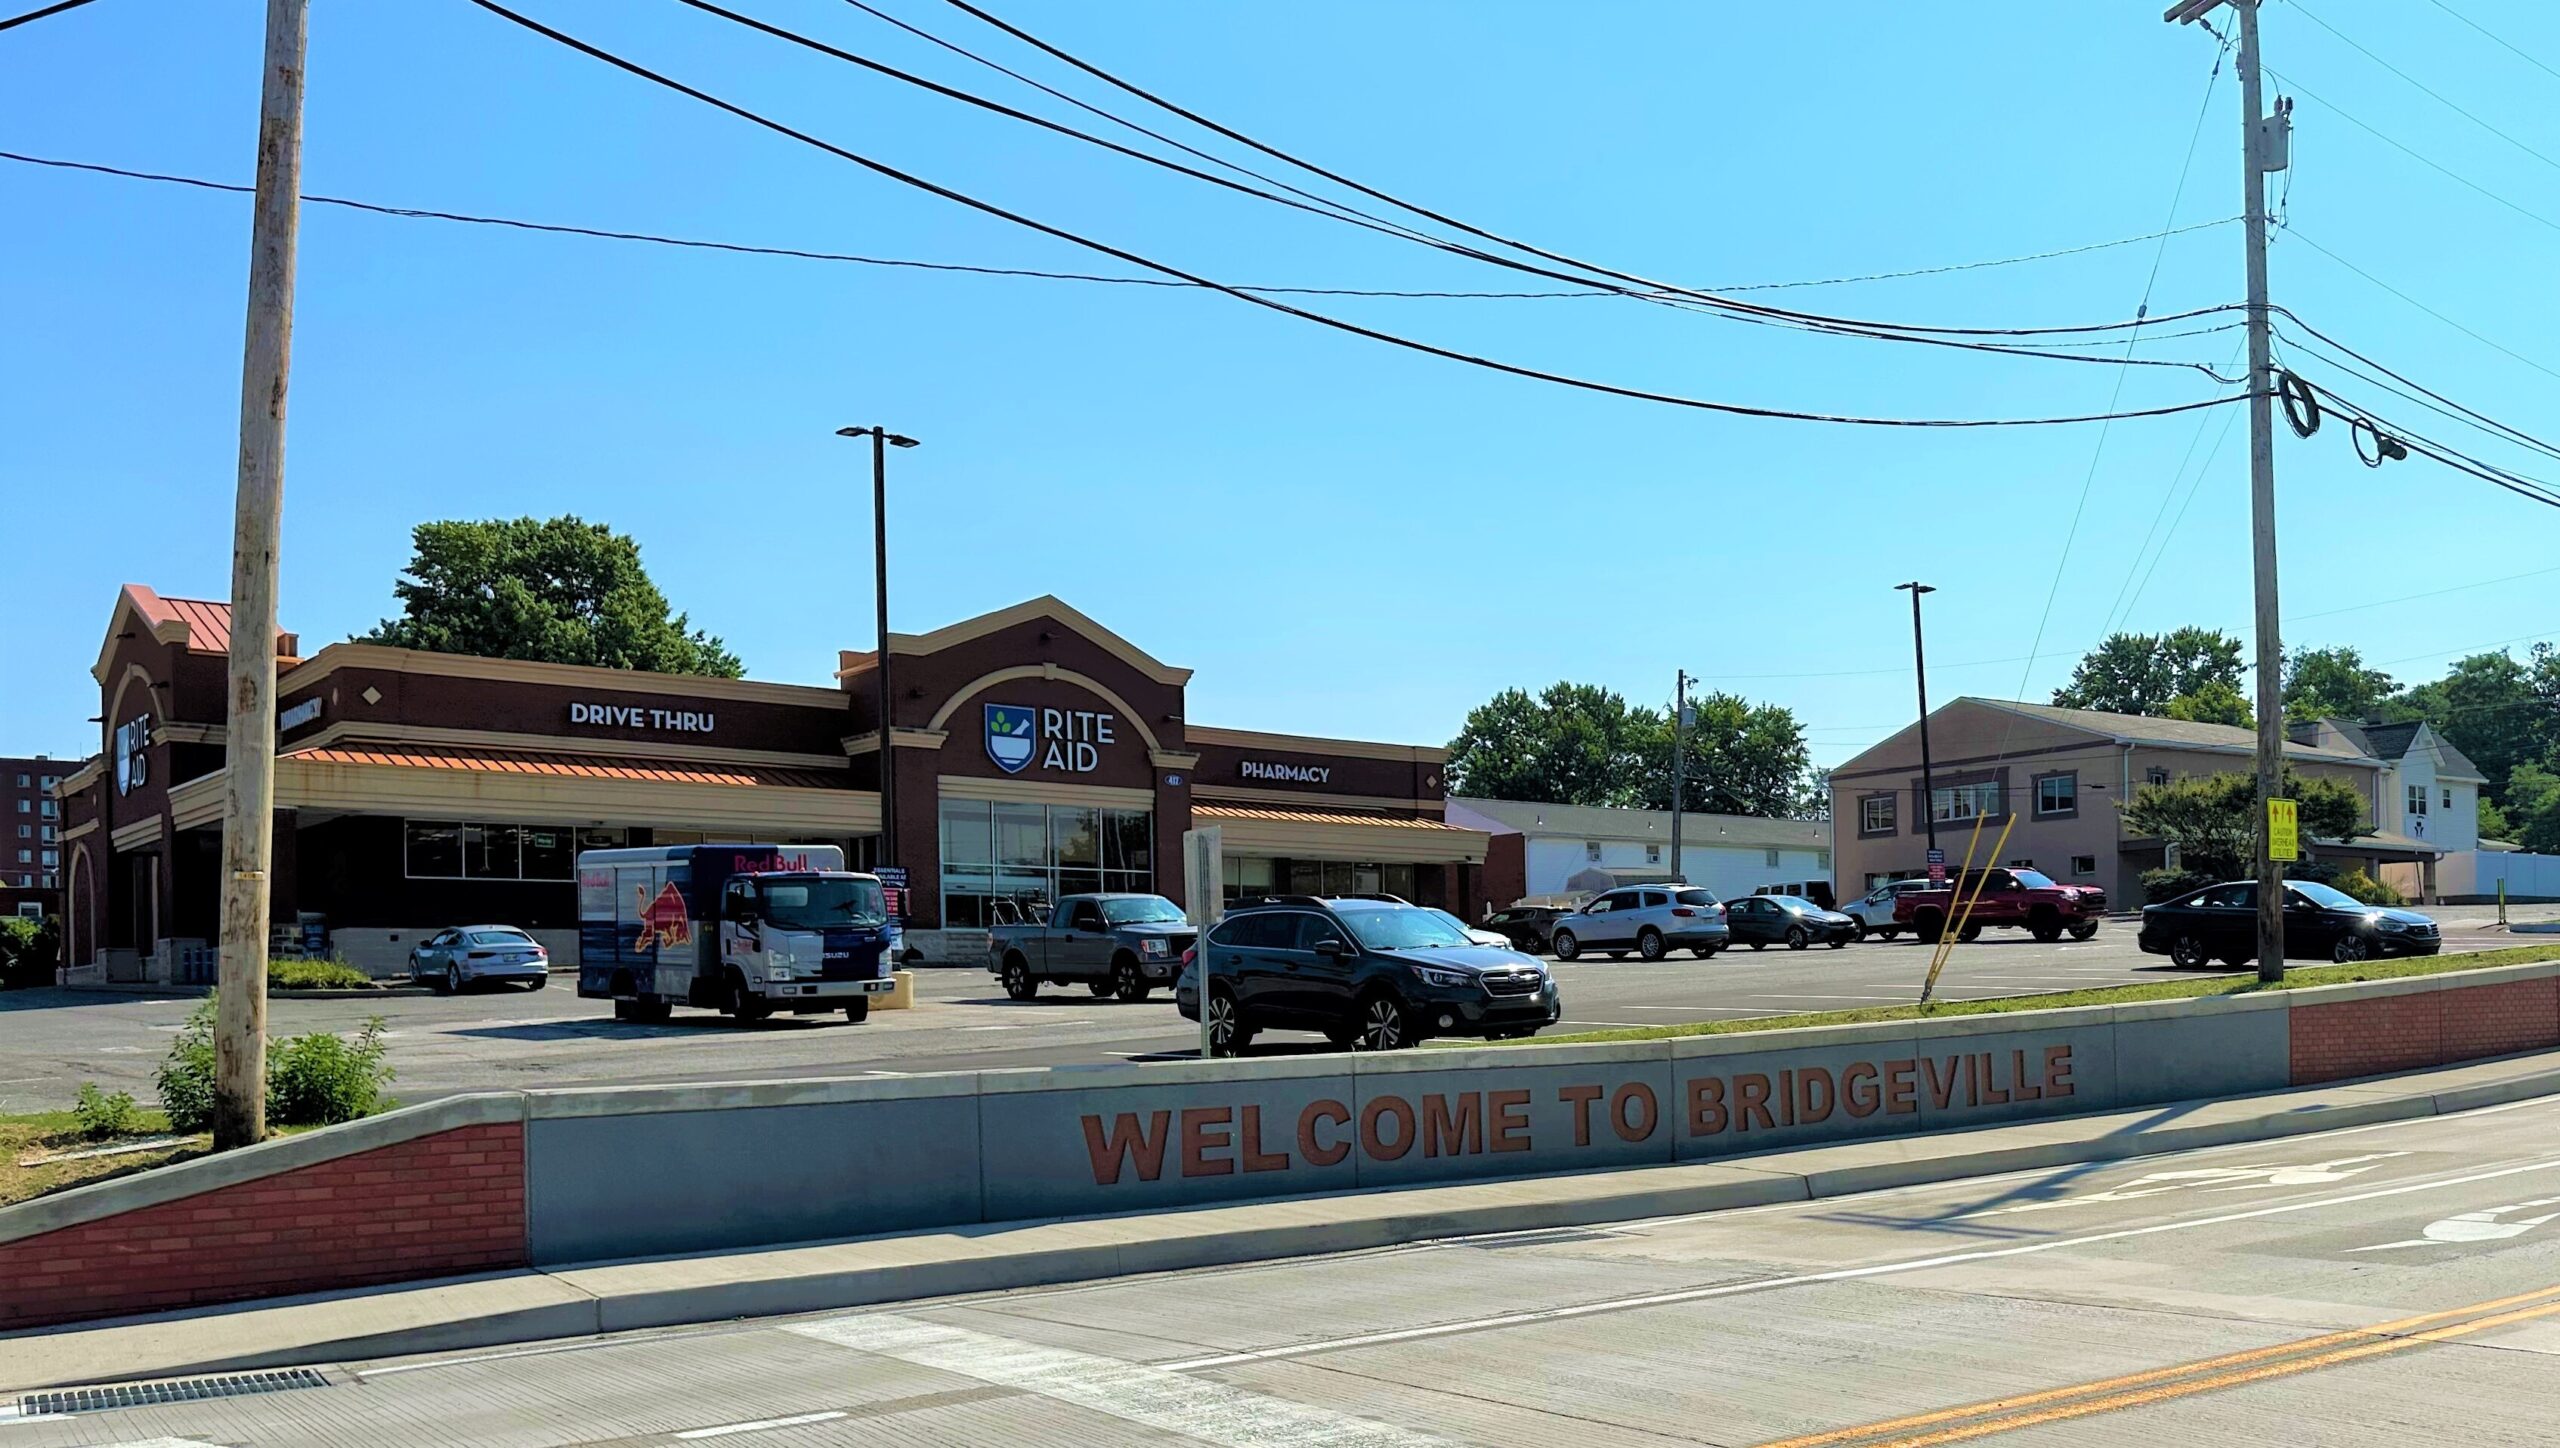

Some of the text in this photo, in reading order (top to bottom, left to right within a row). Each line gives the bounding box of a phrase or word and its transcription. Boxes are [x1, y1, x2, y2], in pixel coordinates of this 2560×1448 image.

[130, 713, 149, 752] RITE
[571, 703, 714, 732] DRIVE THRU
[1044, 709, 1115, 744] RITE
[131, 755, 146, 789] AID
[1043, 740, 1098, 772] AID
[1241, 761, 1330, 783] PHARMACY
[734, 854, 807, 872] Red Bull
[1080, 1045, 2075, 1186] WELCOME TO BRIDGEVILLE
